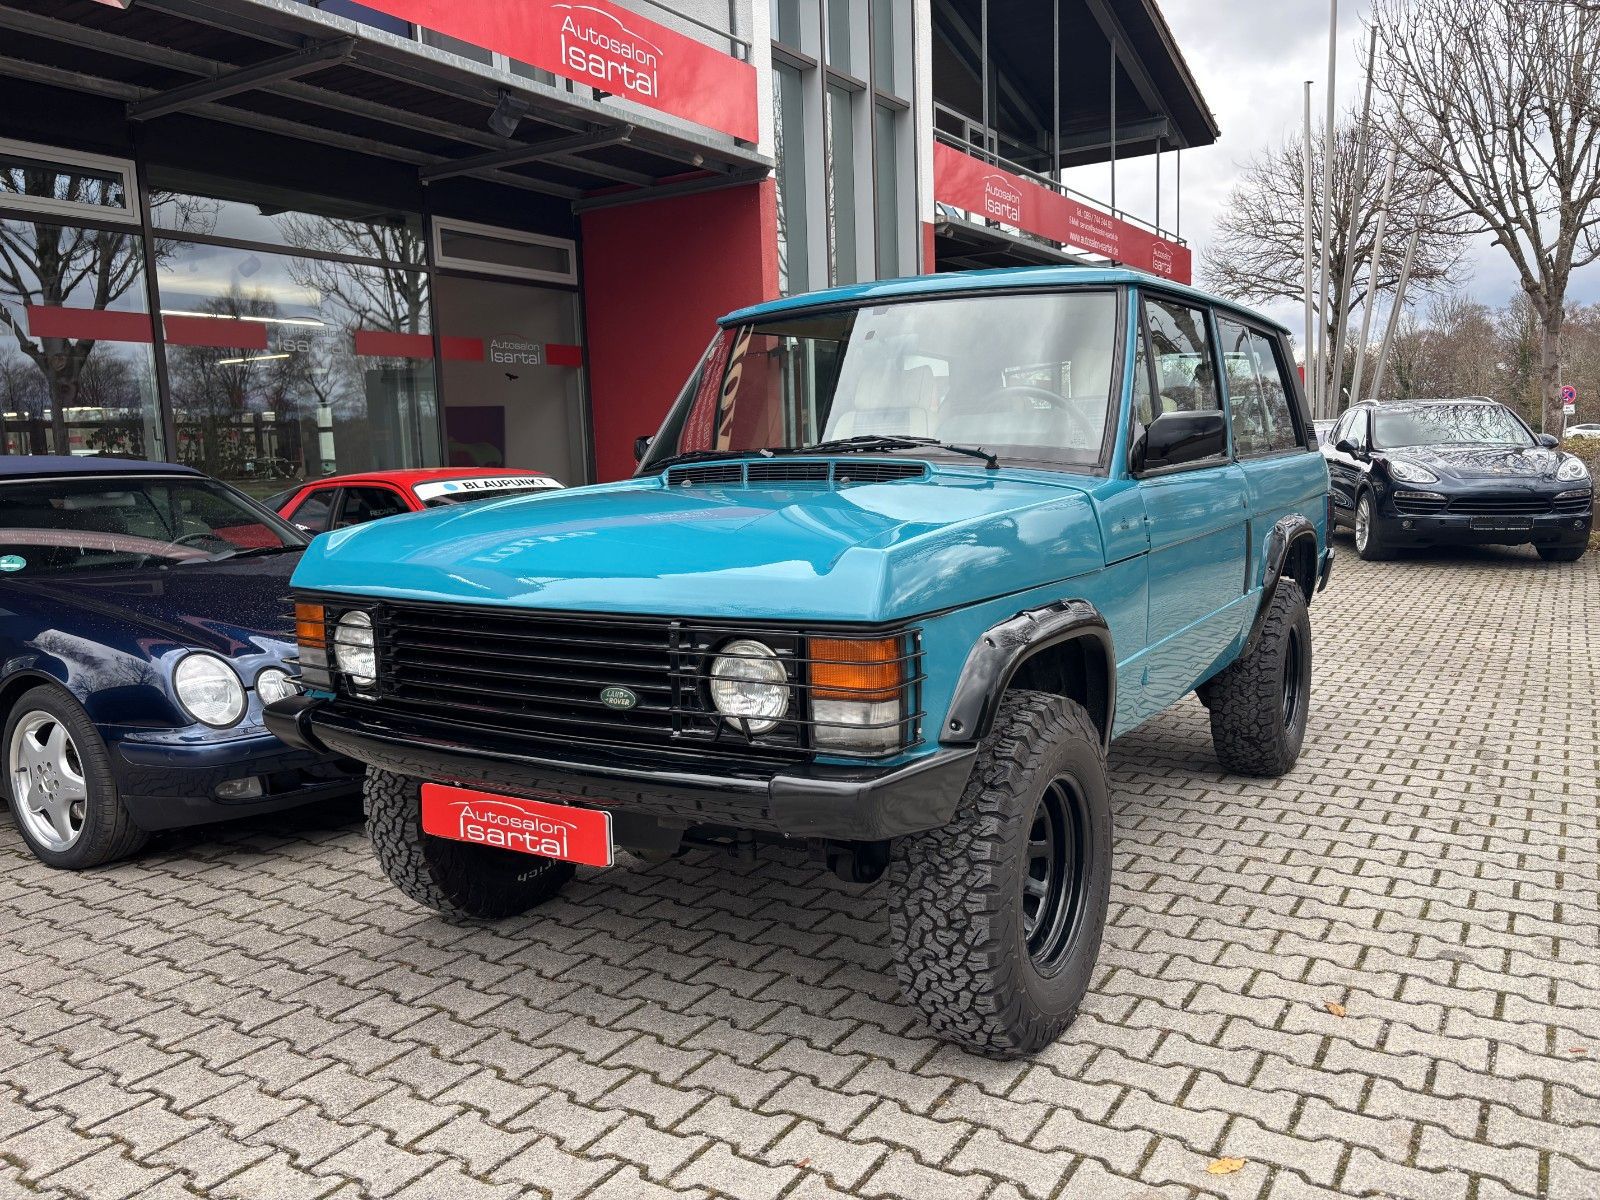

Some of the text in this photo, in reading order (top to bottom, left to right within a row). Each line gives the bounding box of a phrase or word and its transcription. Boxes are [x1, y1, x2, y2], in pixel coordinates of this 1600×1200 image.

[561, 15, 657, 69] Autosalon
[560, 33, 658, 98] Isartal
[985, 181, 1020, 205] Autosalon
[984, 193, 1020, 222] Isartal
[490, 339, 541, 351] Autosalon
[490, 348, 541, 365] Isartal
[461, 478, 547, 490] BLAUPUNKT
[369, 508, 398, 517] RECARO
[607, 690, 624, 698] LAND
[608, 697, 630, 706] ROVER
[460, 804, 567, 837] Autosalon
[459, 815, 568, 858] Isartal
